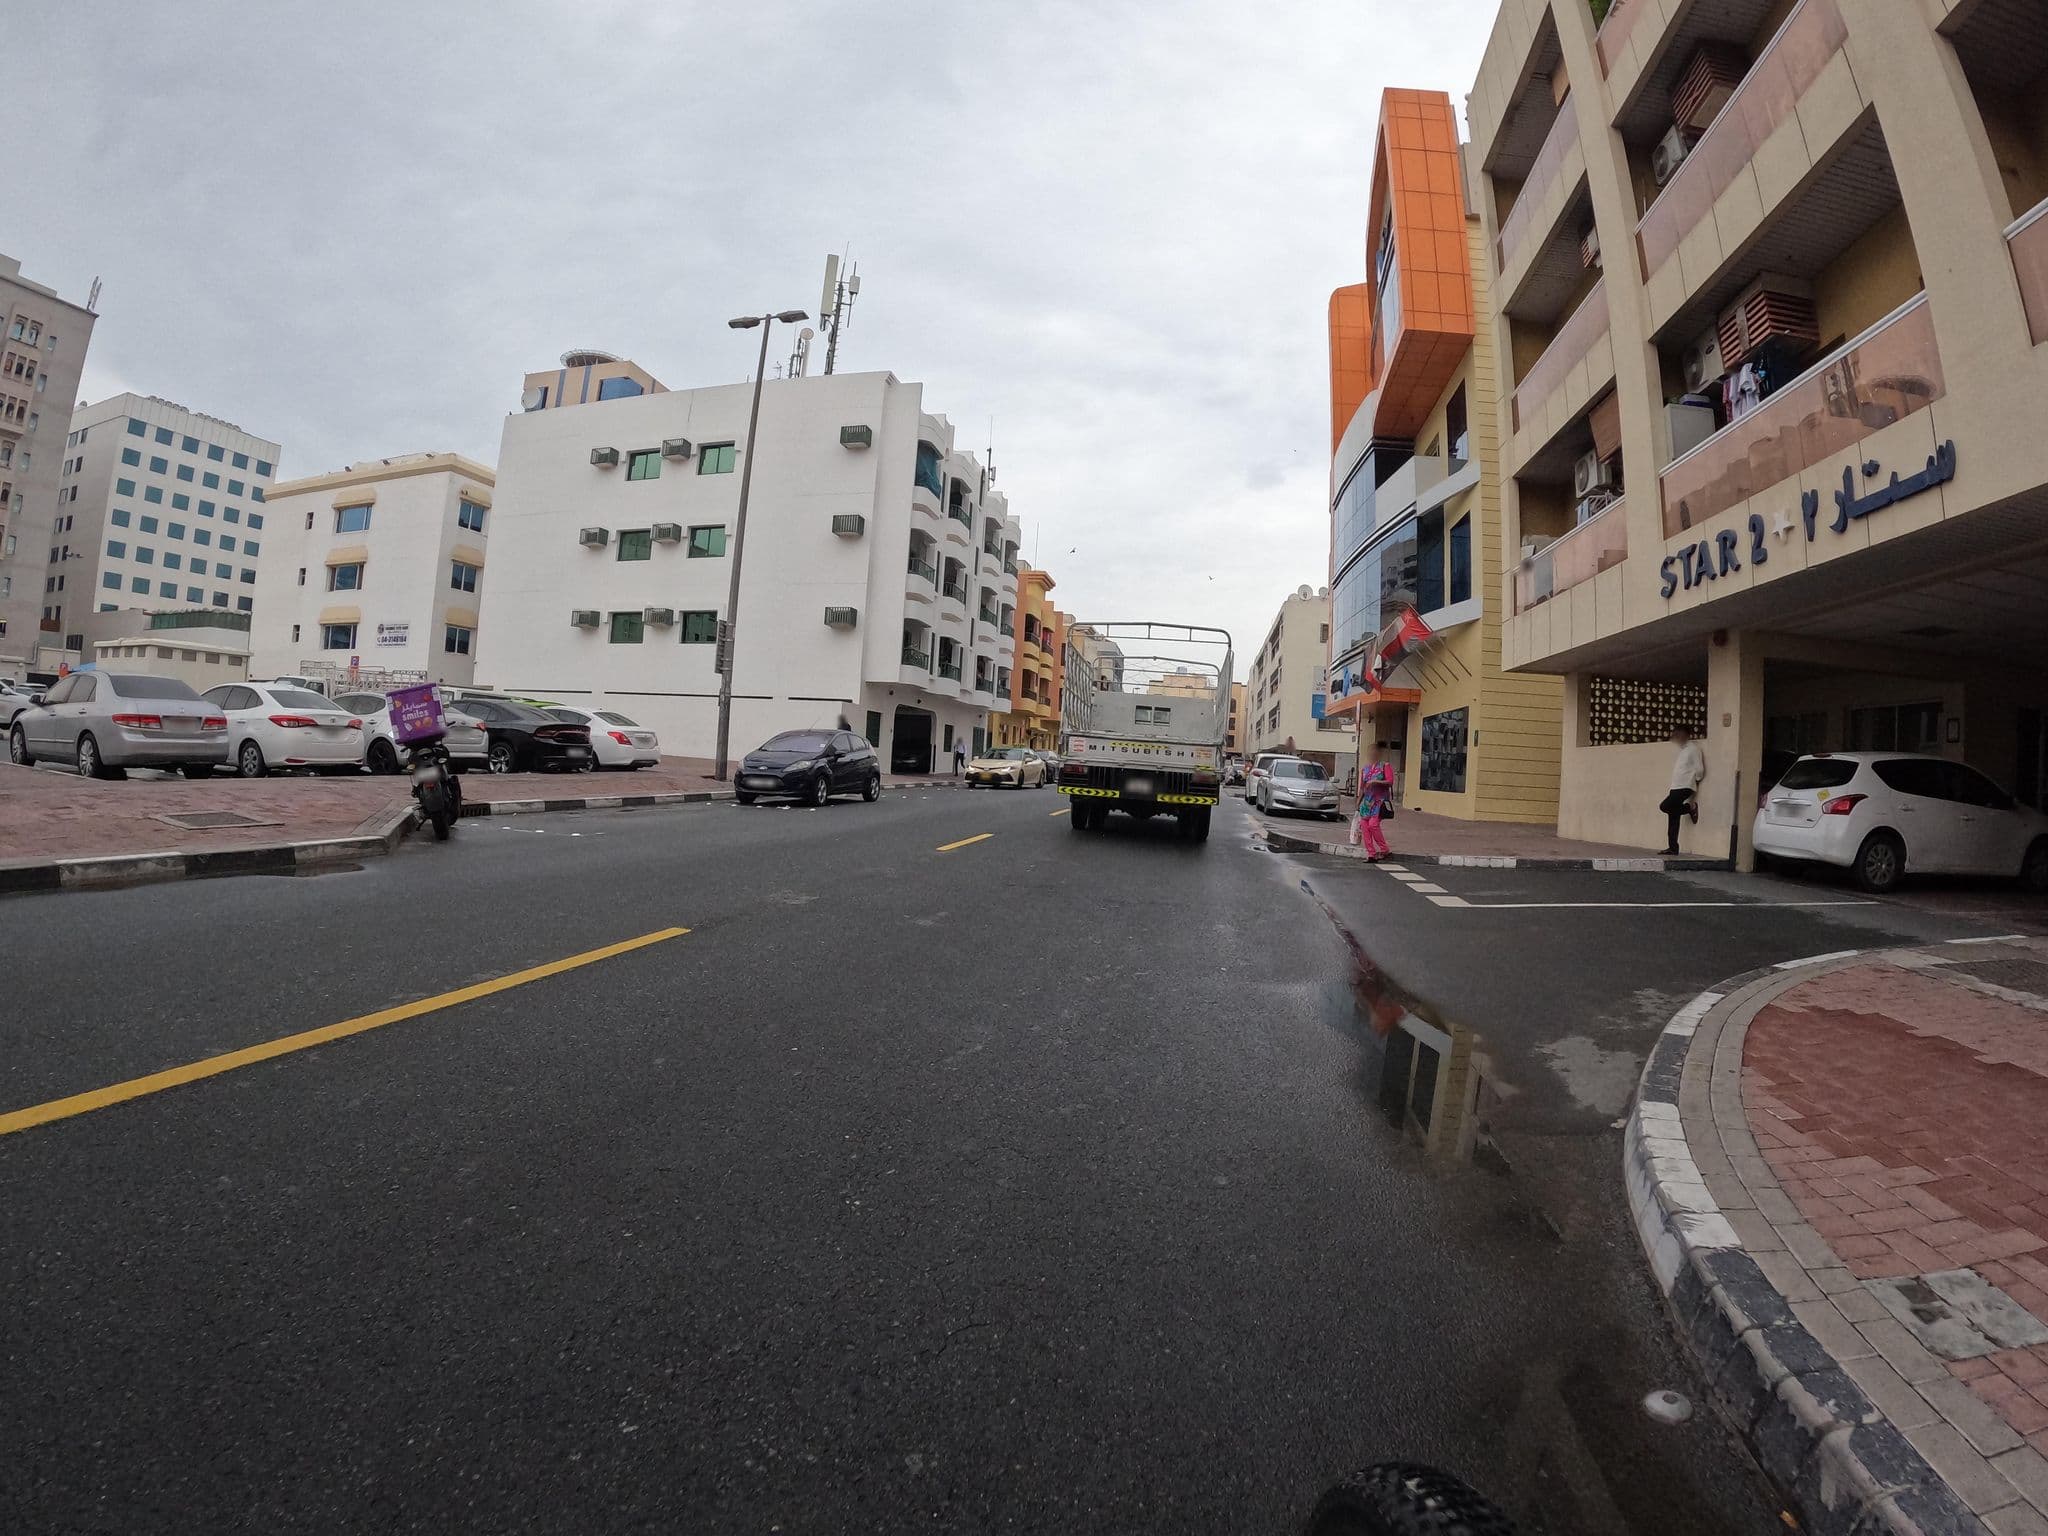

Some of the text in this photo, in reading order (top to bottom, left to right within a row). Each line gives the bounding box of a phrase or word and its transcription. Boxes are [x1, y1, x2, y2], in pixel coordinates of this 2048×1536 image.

[1828, 439, 1957, 534] ستار
[1660, 513, 1768, 599] STAR 2
[402, 709, 429, 721] smiles
[1088, 744, 1194, 758] MITSUBISHI
